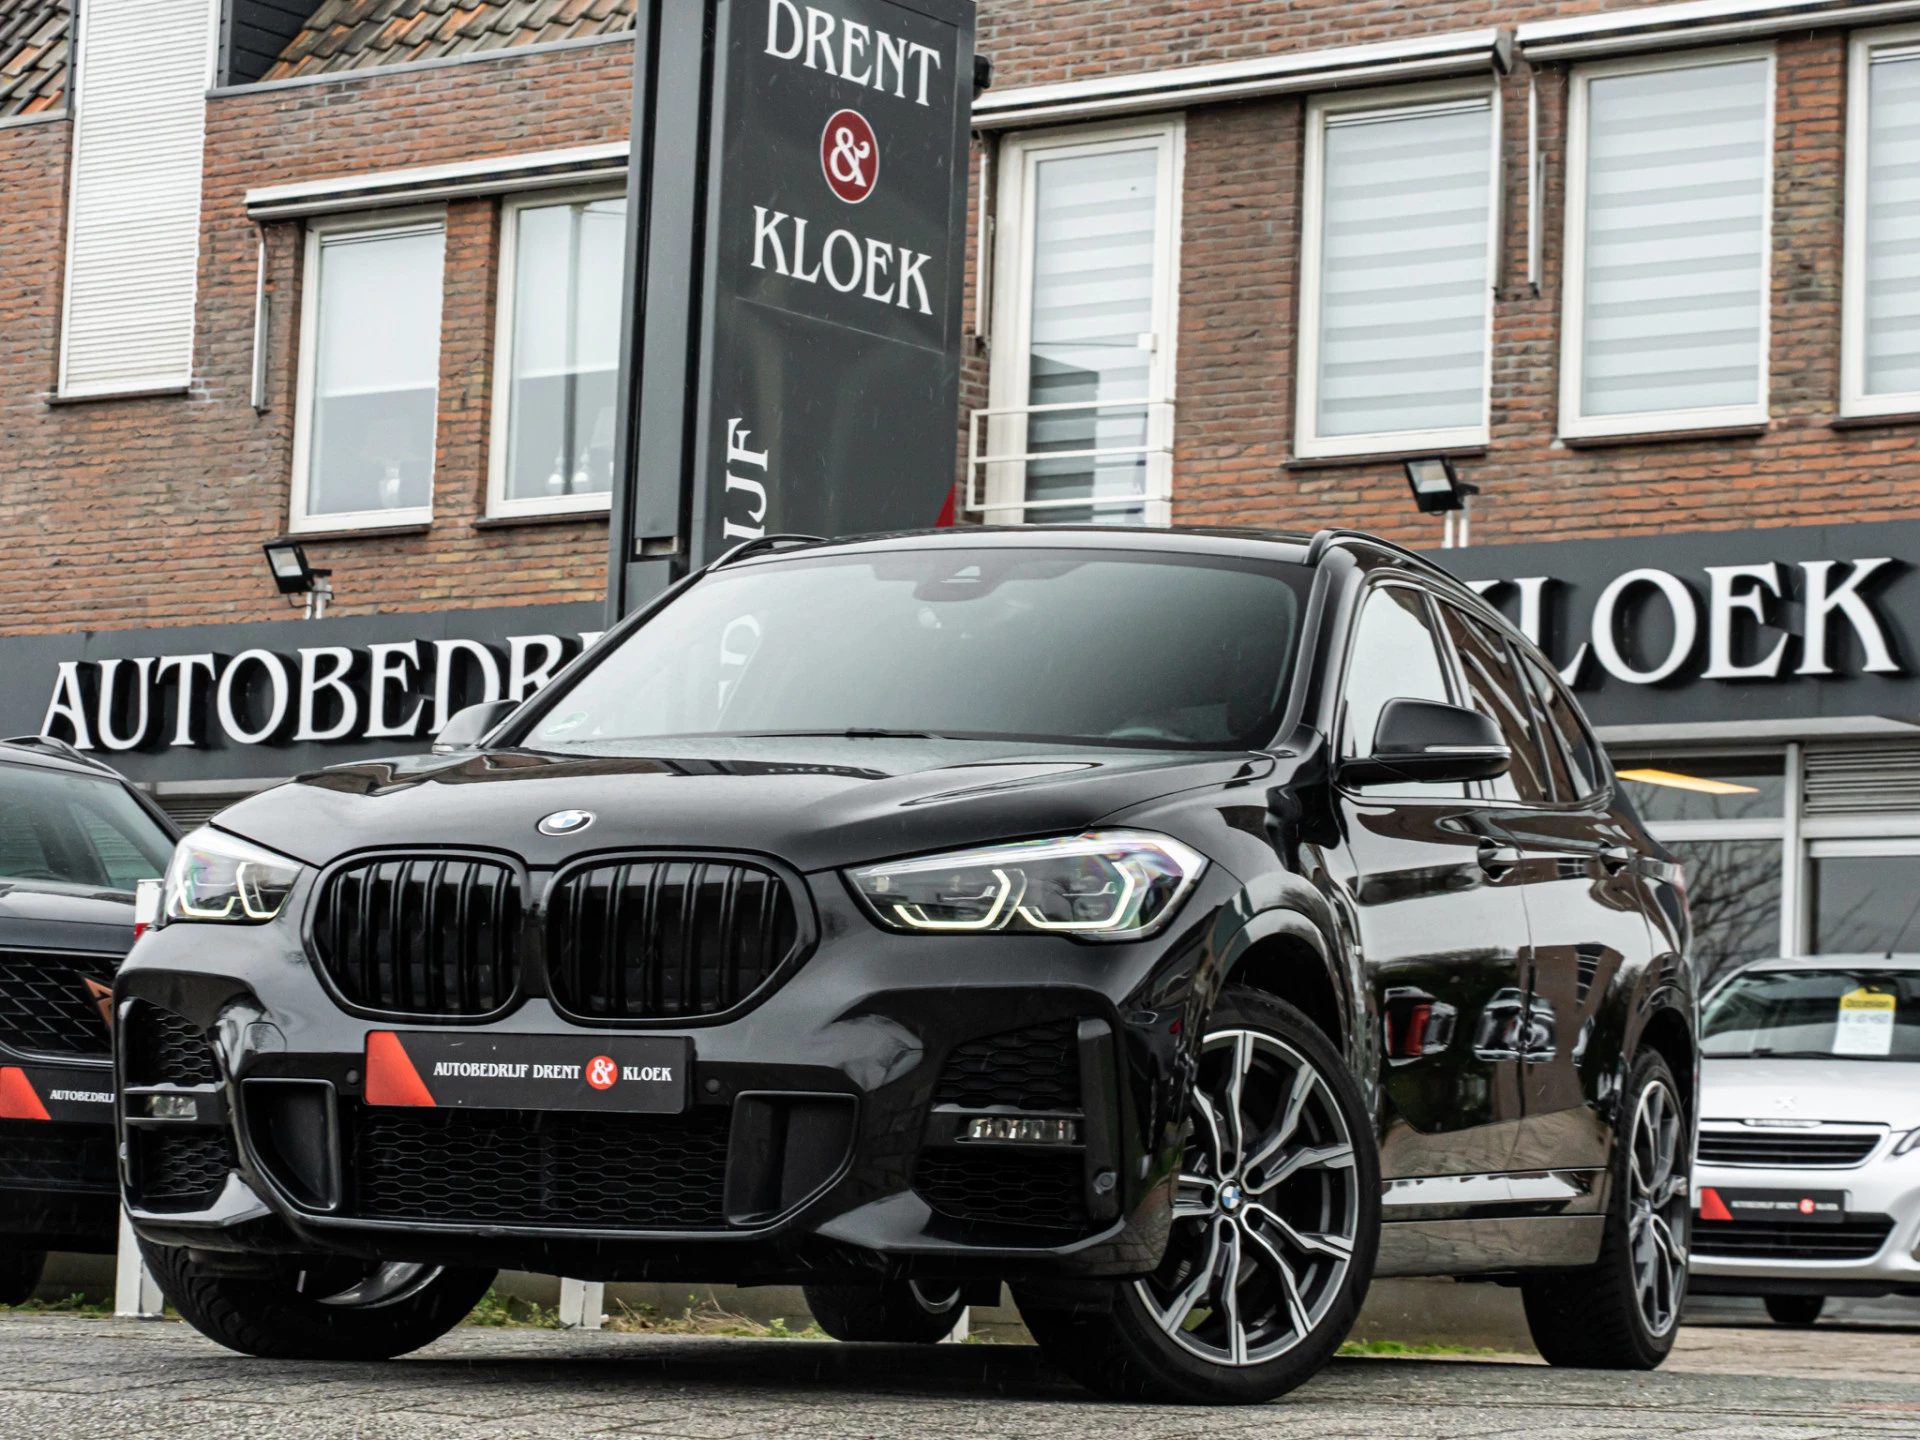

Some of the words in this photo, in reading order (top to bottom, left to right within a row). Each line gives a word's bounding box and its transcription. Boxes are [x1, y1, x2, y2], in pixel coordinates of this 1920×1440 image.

[764, 0, 942, 107] DRENT
[829, 127, 871, 188] &
[750, 205, 934, 316] KLOEK
[40, 631, 606, 750] AUTOBEDR
[1464, 557, 1901, 686] LOEK
[433, 1062, 529, 1078] AUTOBEDRIJF
[533, 1064, 581, 1079] DRENT
[591, 1059, 614, 1084] &
[622, 1066, 673, 1082] KLOEK
